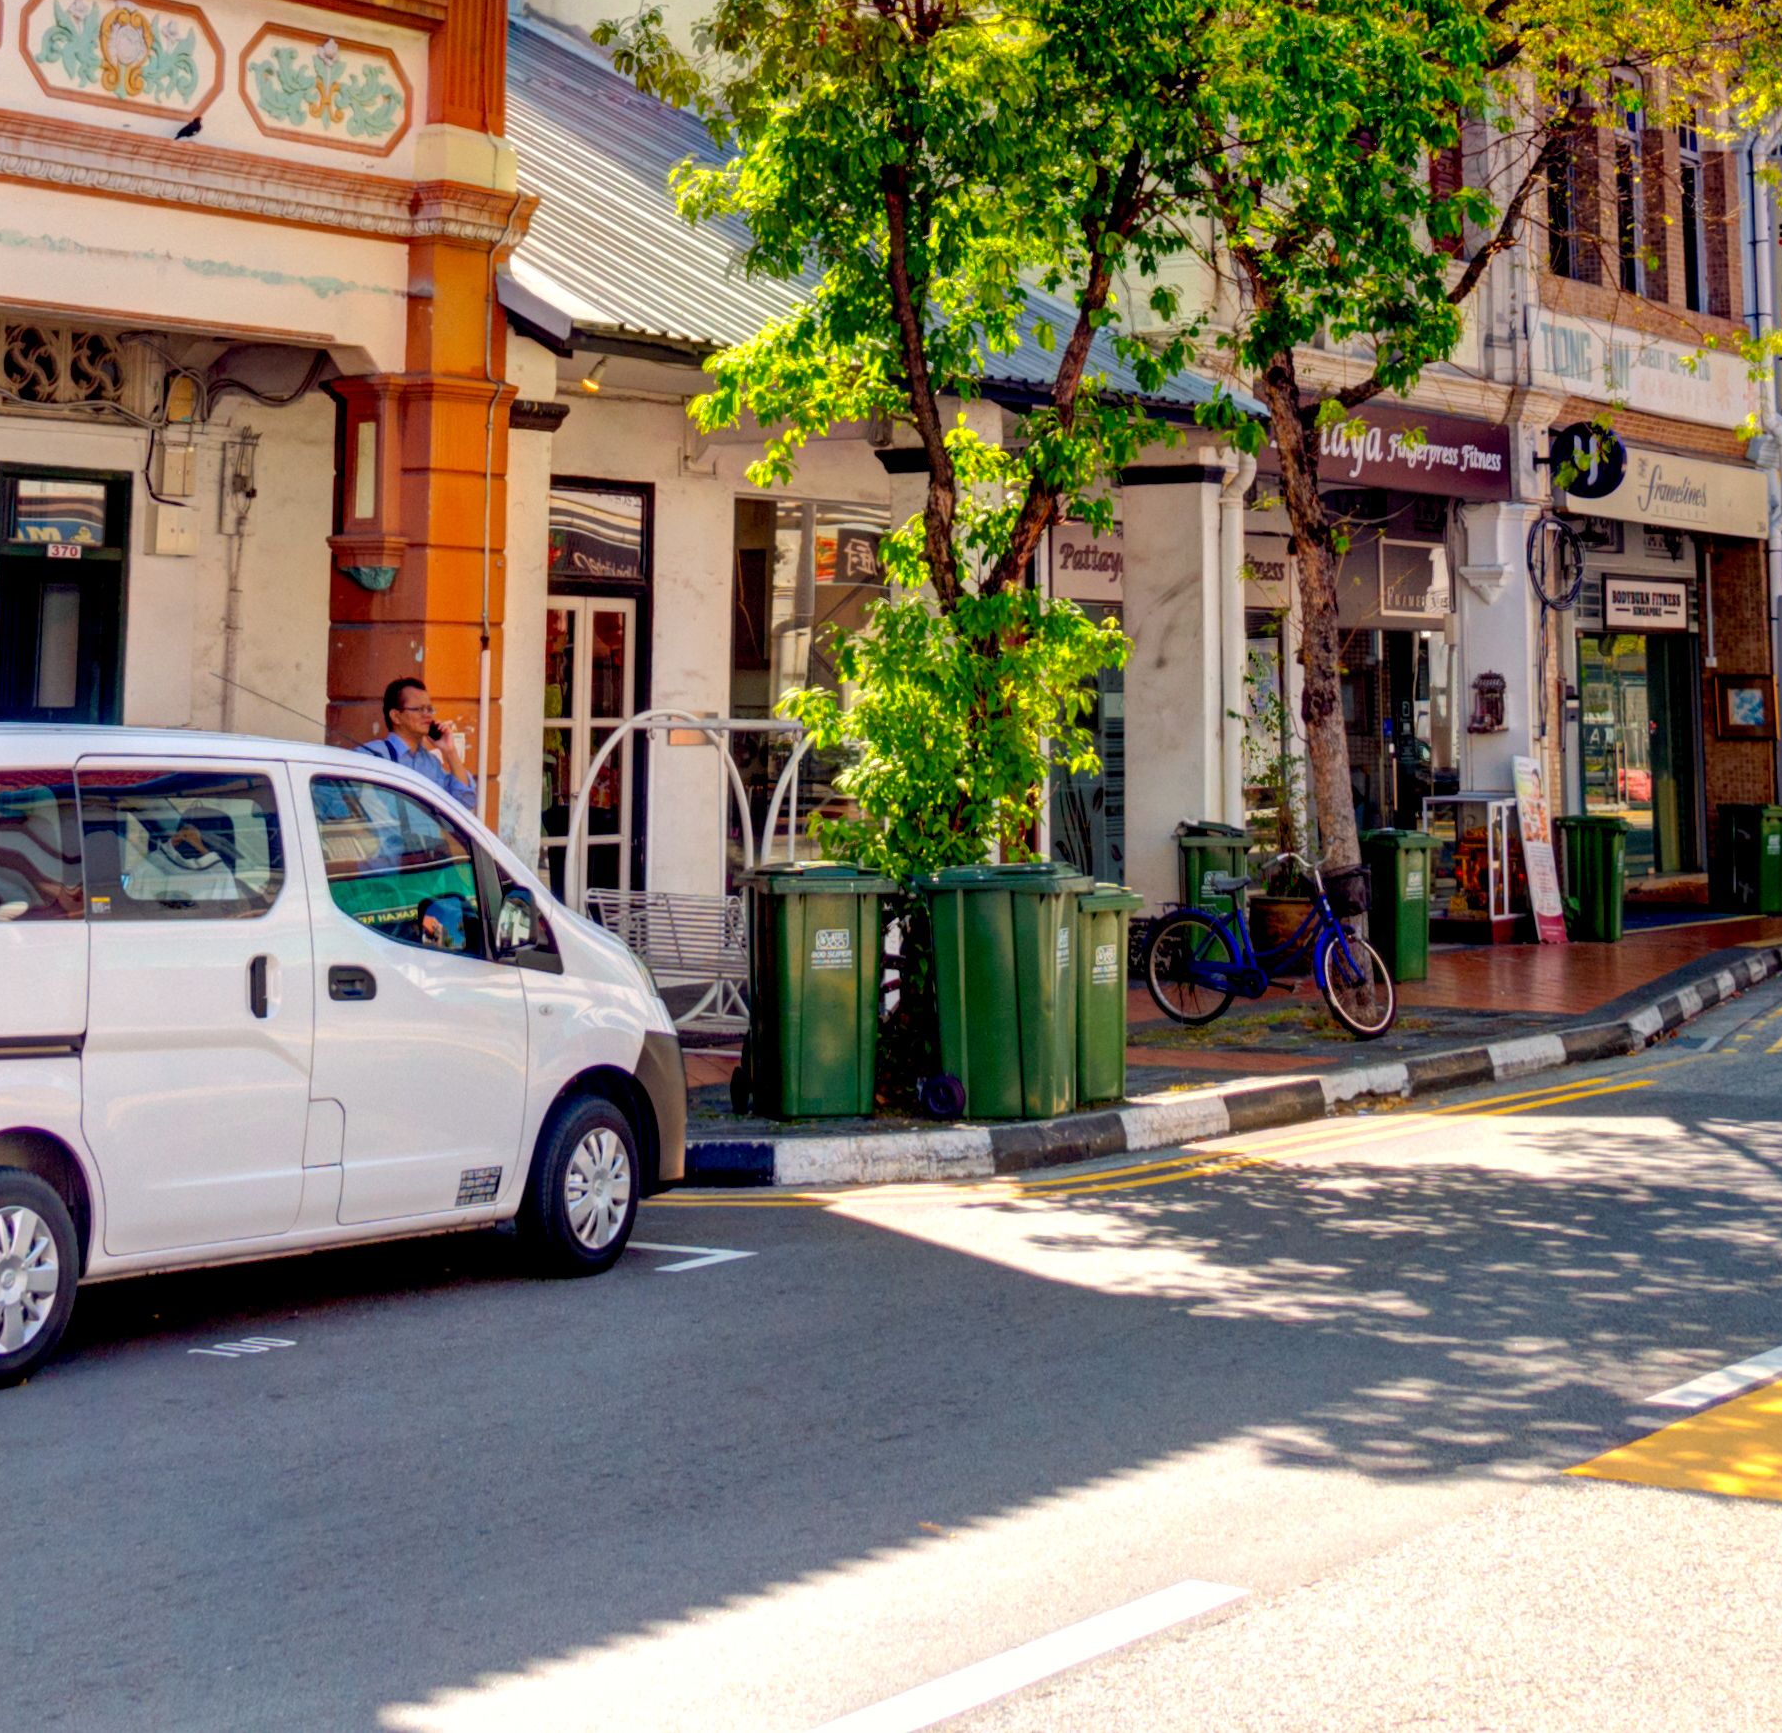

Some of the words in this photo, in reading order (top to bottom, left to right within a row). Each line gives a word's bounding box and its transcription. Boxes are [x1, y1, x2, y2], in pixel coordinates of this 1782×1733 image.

[1460, 444, 1502, 472] Fitness
[51, 545, 79, 557] 370
[1059, 543, 1123, 582] Pattay
[1612, 590, 1650, 605] BODYBURN
[1652, 593, 1681, 607] FITNESS
